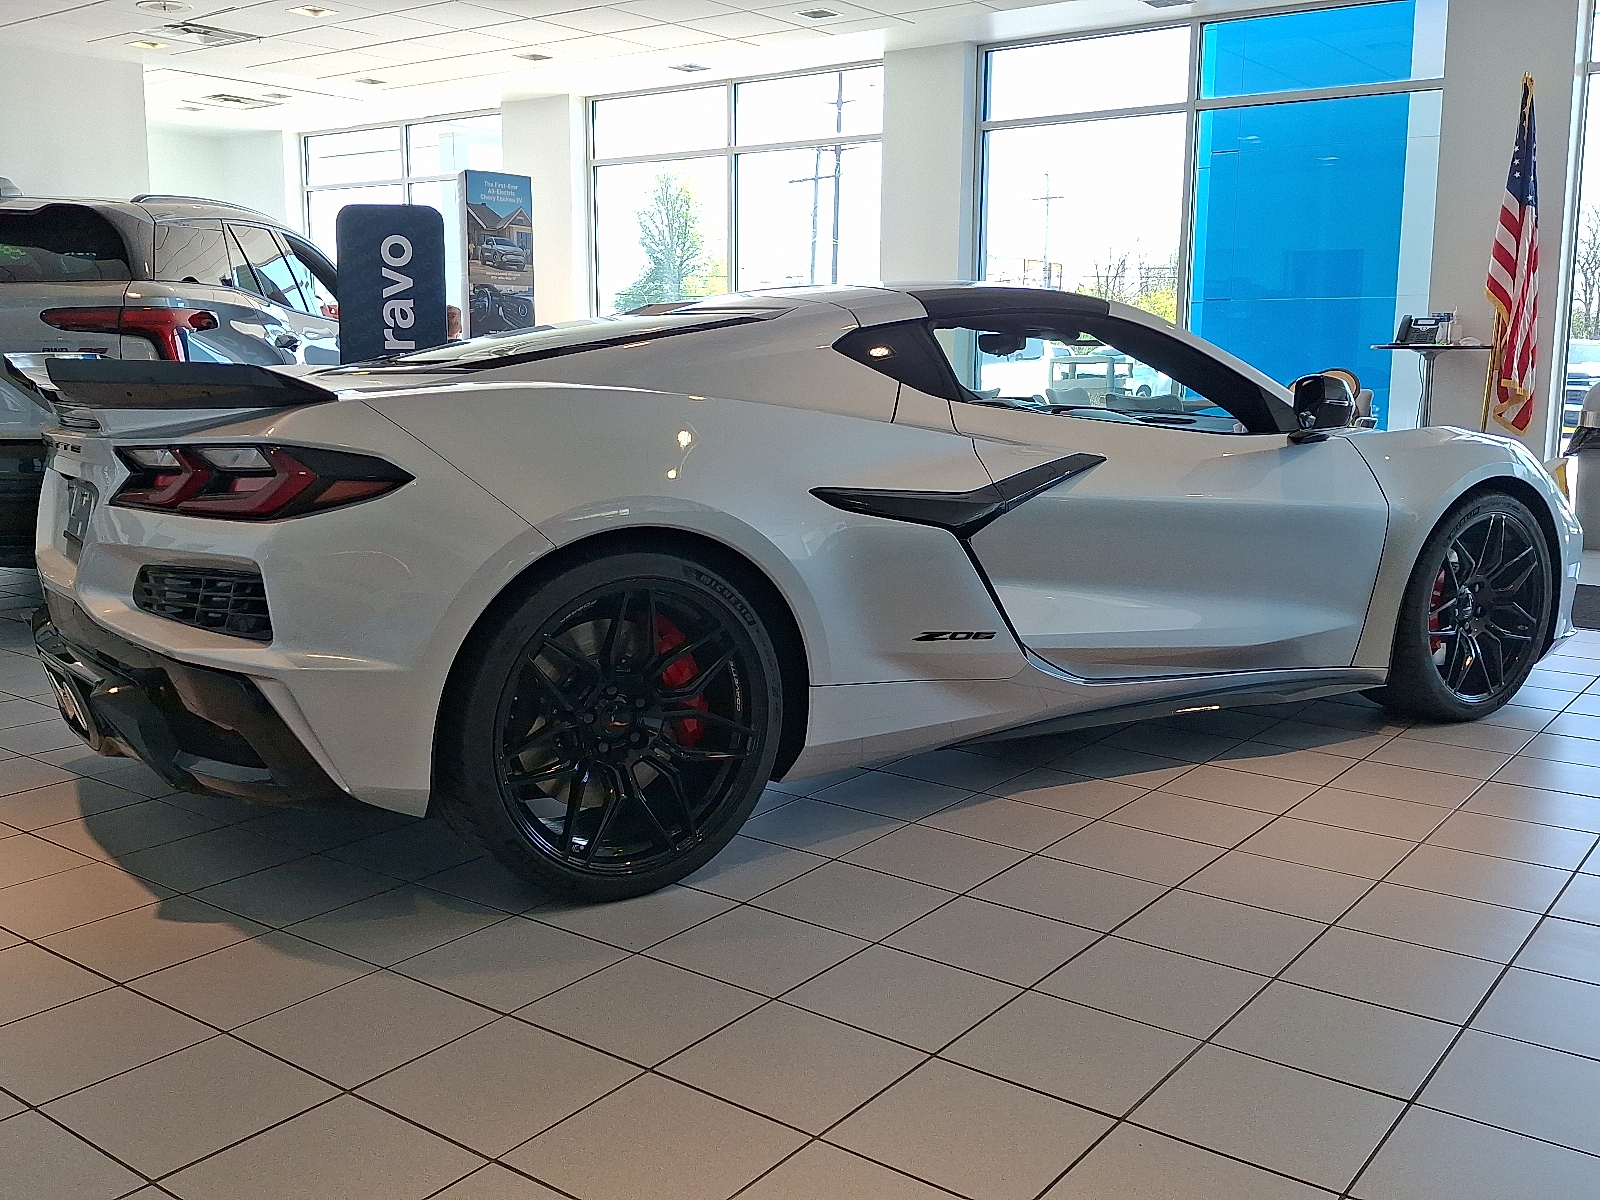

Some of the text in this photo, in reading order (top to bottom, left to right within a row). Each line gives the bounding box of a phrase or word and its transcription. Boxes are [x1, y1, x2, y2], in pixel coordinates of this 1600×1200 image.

[484, 180, 518, 190] The First-Ever
[487, 188, 515, 196] All-Electric
[480, 193, 496, 202] Chevy
[700, 573, 756, 626] MICHELIN
[911, 630, 997, 642] Z06
